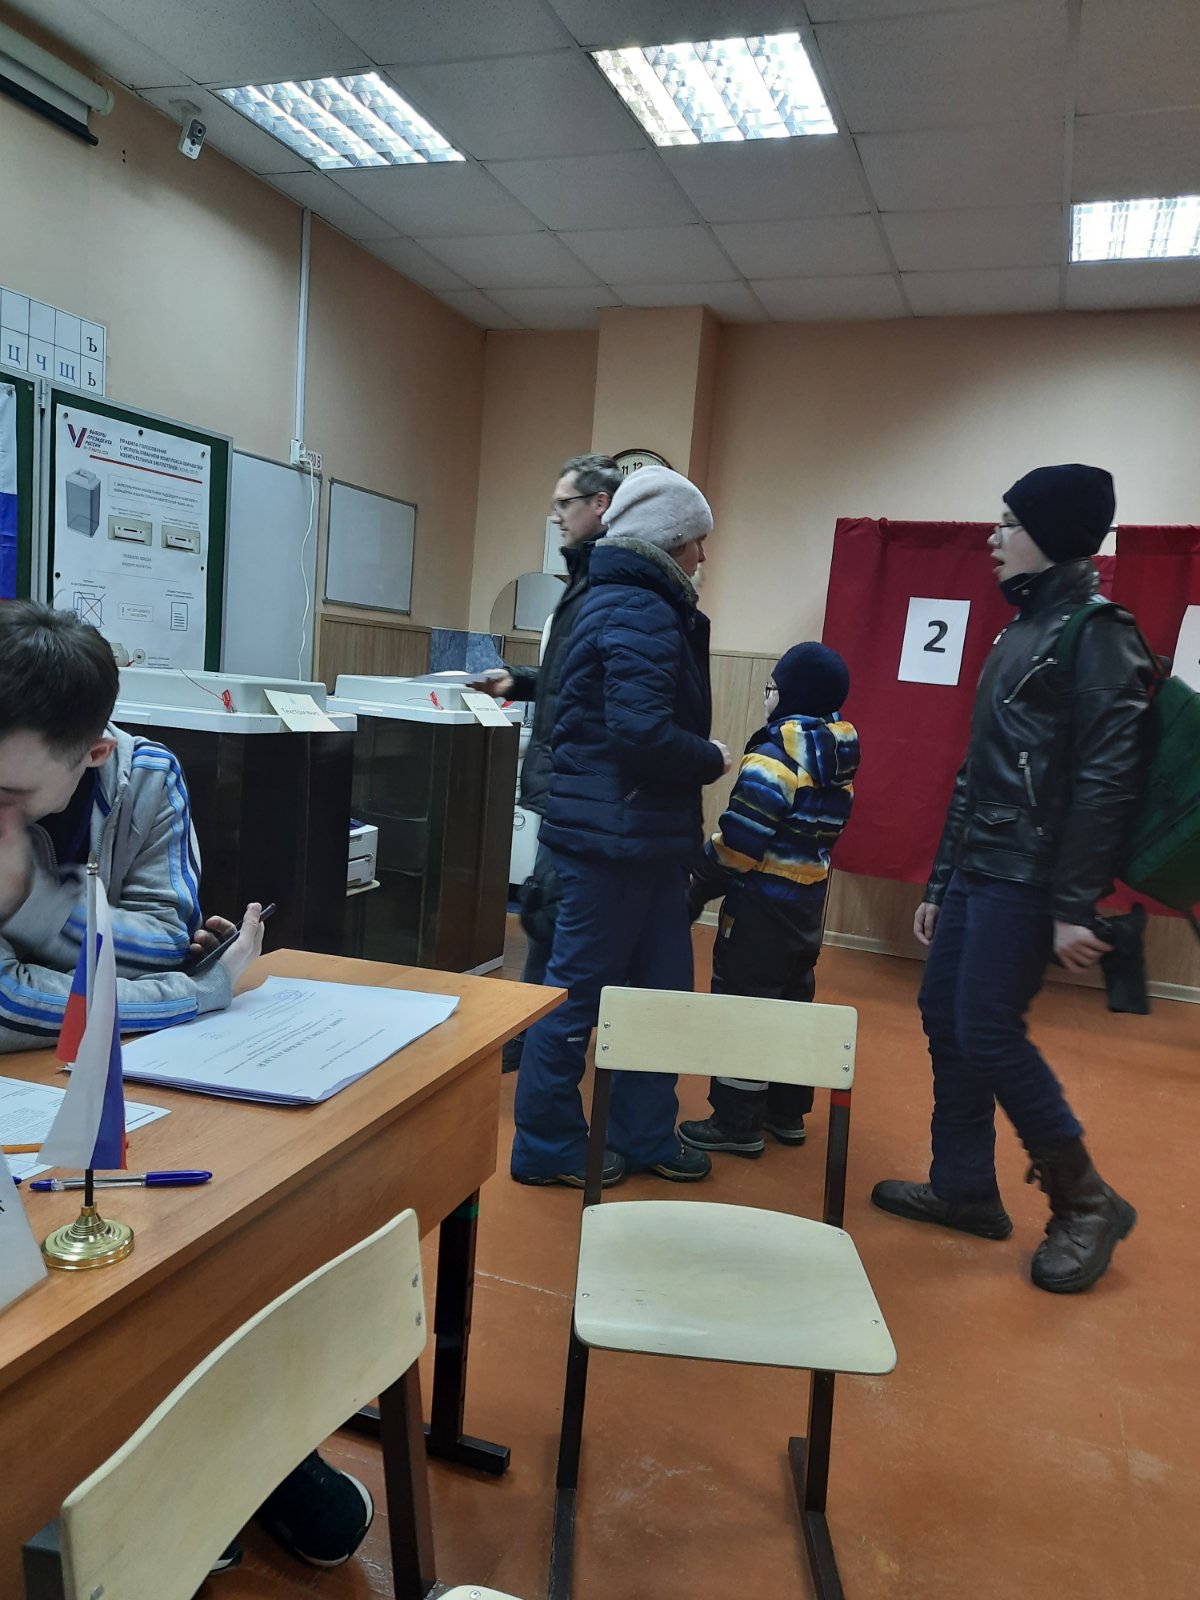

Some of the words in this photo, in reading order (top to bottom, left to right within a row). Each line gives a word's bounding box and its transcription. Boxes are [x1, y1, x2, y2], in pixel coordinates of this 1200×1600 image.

[86, 336, 97, 352] Ъ
[8, 344, 20, 365] Ц
[36, 354, 46, 371] Ч
[59, 362, 75, 382] Щ
[87, 371, 97, 386] Ь
[923, 620, 948, 653] 2
